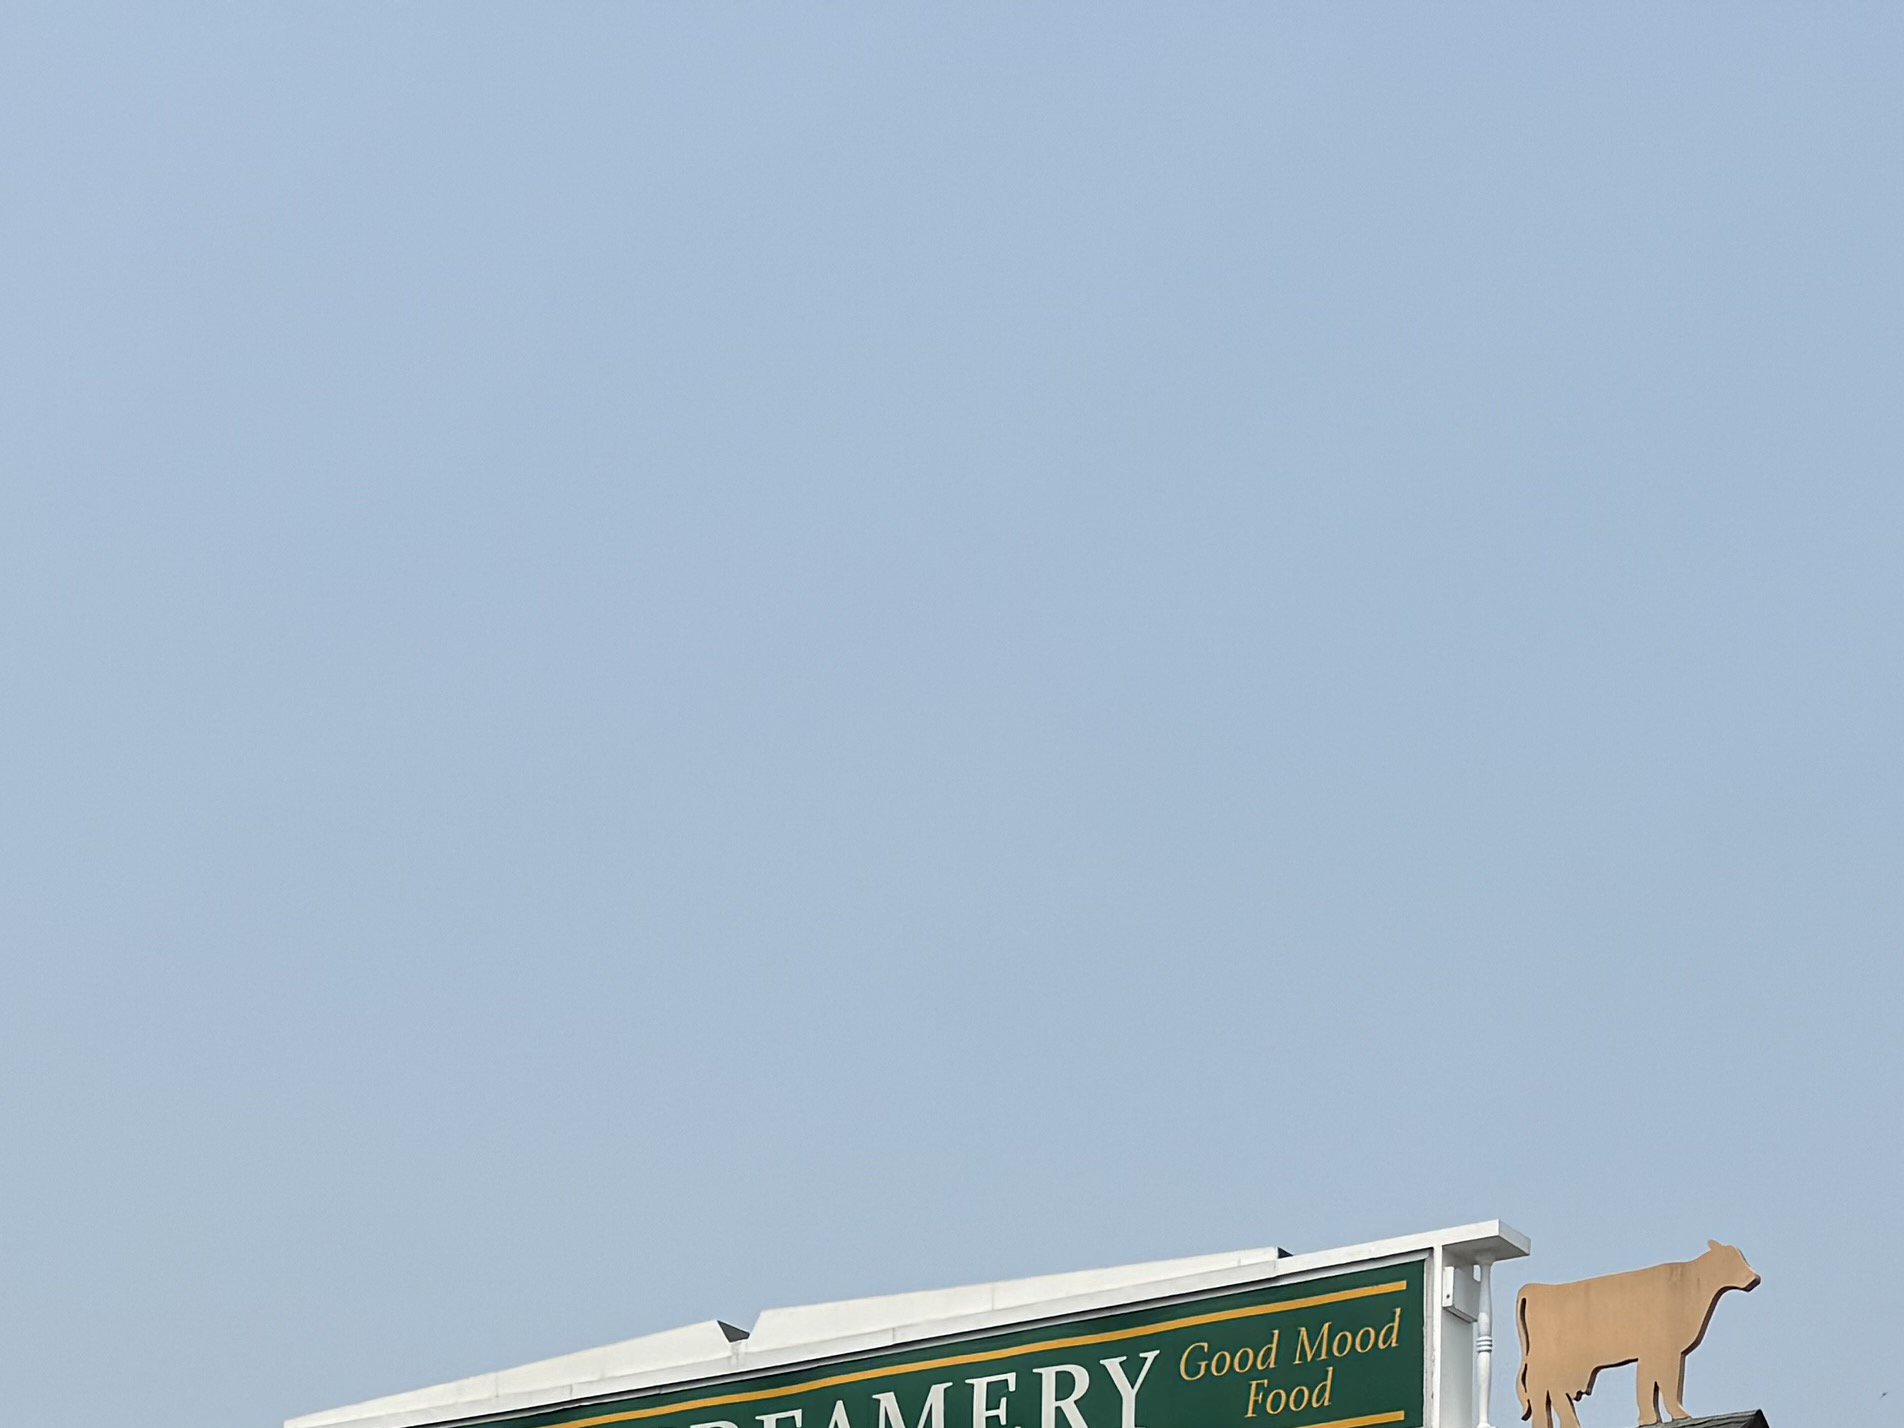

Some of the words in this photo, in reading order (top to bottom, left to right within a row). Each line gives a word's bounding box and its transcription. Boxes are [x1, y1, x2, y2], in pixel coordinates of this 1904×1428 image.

[1179, 1330, 1280, 1382] Good
[1293, 1308, 1402, 1365] Mood
[1244, 1366, 1334, 1418] Food
